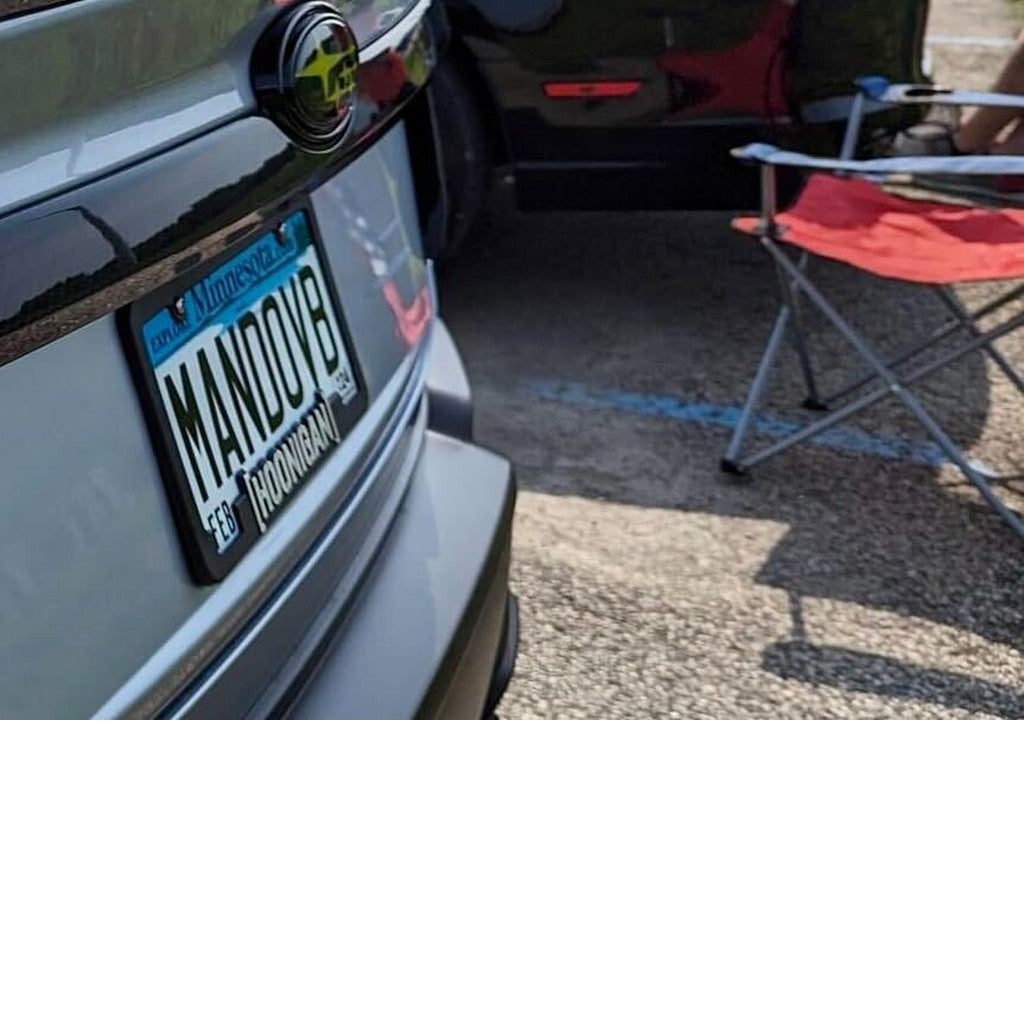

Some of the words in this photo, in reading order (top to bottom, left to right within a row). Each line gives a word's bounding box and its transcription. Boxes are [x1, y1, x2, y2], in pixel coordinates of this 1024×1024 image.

[190, 243, 275, 320] Minnesota
[164, 265, 339, 503] MANDOVB
[207, 500, 237, 549] FEB
